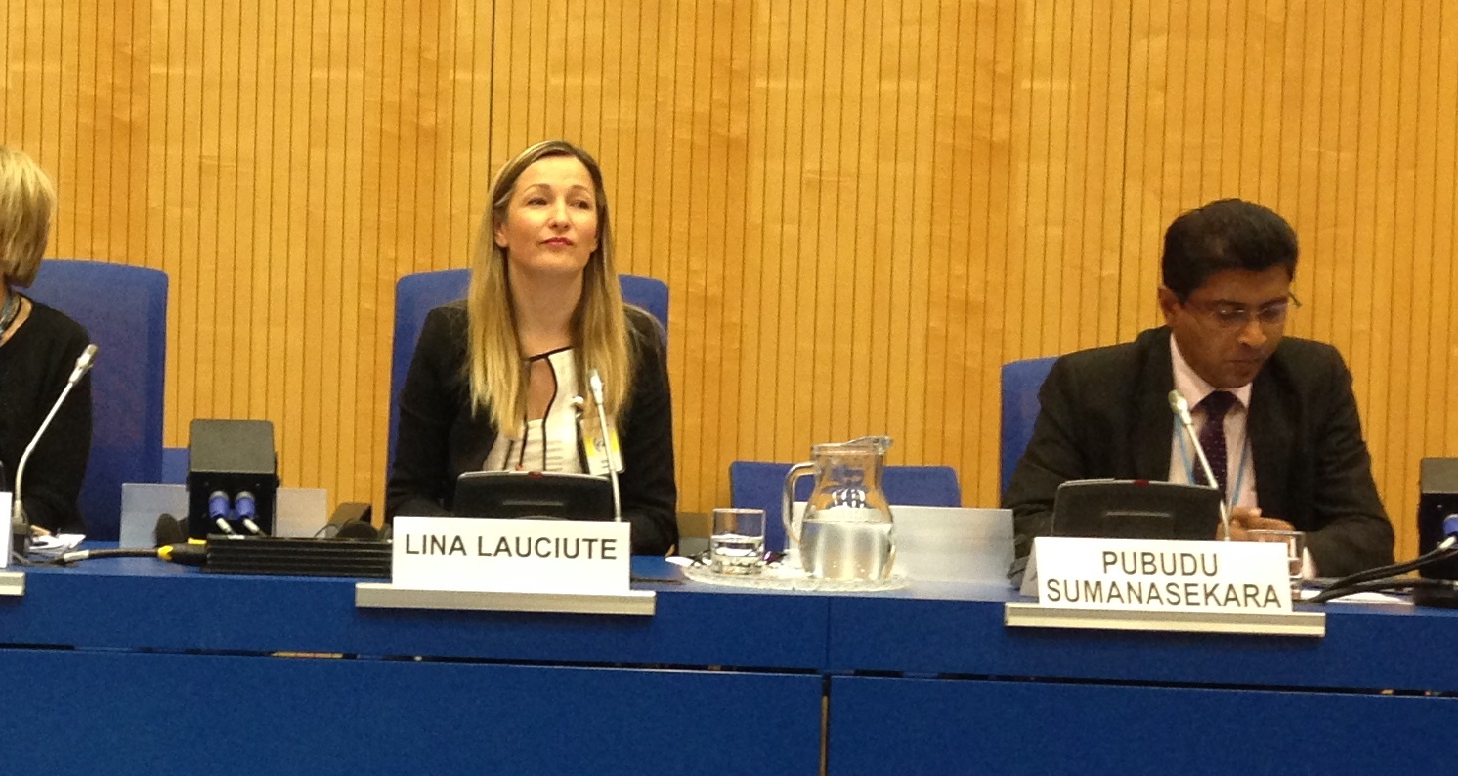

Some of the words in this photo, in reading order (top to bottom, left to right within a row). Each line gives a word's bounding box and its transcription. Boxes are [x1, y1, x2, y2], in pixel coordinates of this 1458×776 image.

[405, 533, 467, 556] LINA
[477, 535, 618, 560] LAUCIUTE
[1102, 550, 1218, 577] PUBUDU
[1047, 578, 1282, 608] SUMANASEKARA
